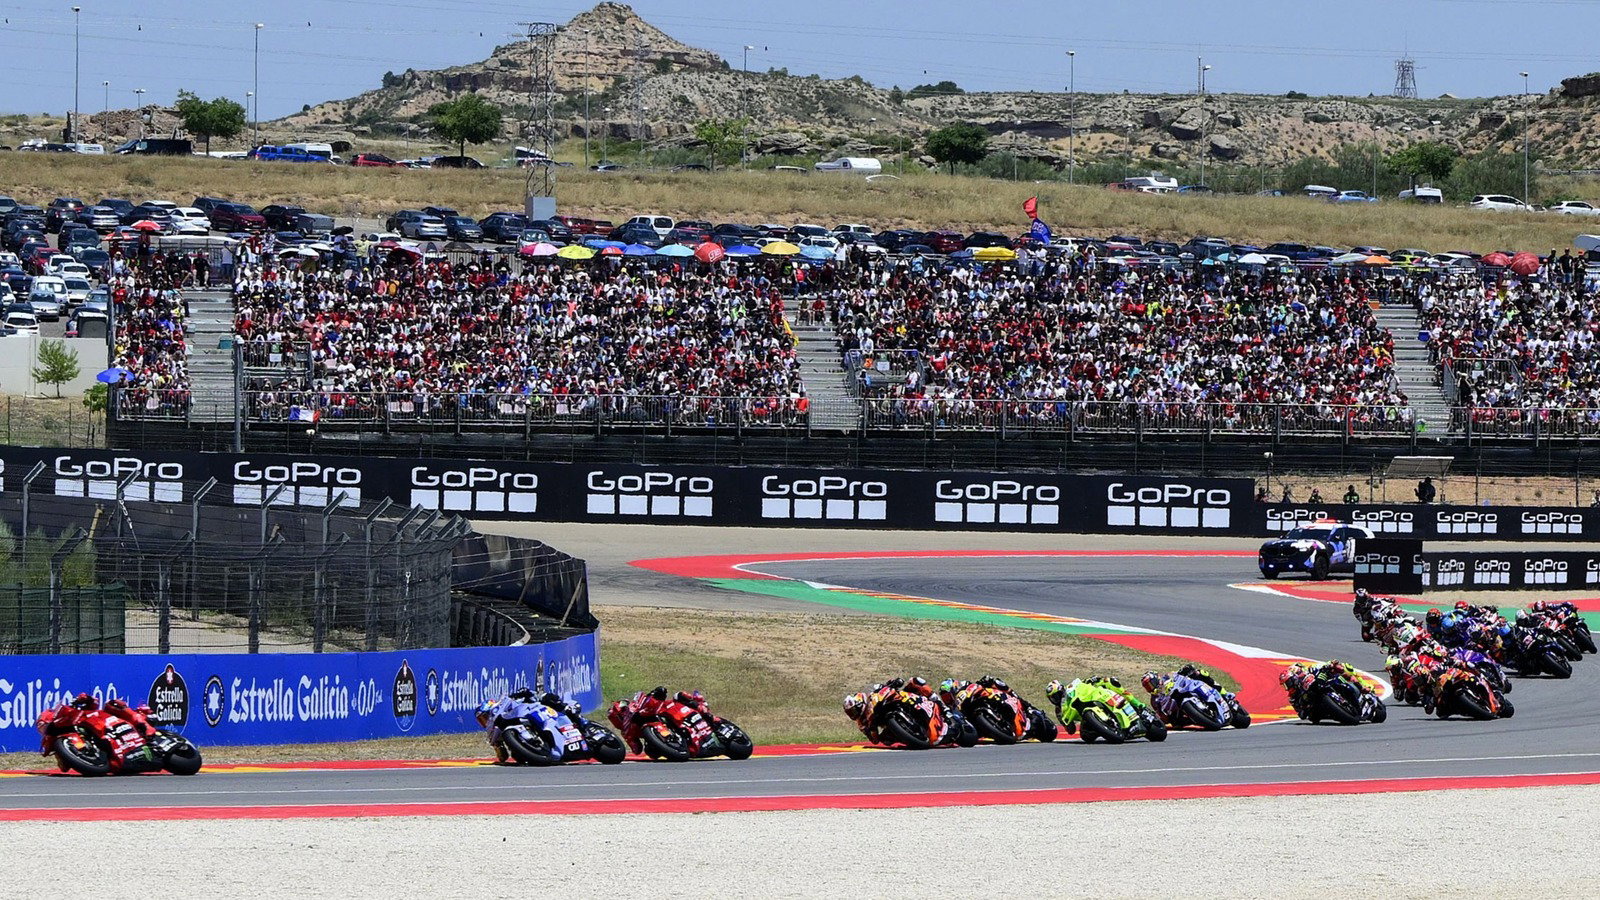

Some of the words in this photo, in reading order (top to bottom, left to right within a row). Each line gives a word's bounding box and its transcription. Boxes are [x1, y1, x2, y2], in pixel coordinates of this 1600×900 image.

[55, 455, 183, 480] GoPro
[234, 460, 362, 485] GoPro
[411, 466, 538, 489] GoPro
[587, 470, 714, 493] GoPro
[761, 475, 887, 497] GoPro
[935, 479, 1060, 502] GoPro
[1107, 482, 1231, 505] GoPro
[1266, 508, 1328, 520] GoPro
[1352, 510, 1414, 521] GoPro
[1436, 511, 1498, 522] GoPro
[1521, 511, 1583, 523] GoPro
[1355, 553, 1400, 564] oPro
[1437, 559, 1465, 571] GoPro
[1474, 559, 1511, 571] GoPro
[1524, 558, 1568, 571] GoPro
[155, 686, 184, 703] Estrella
[228, 676, 294, 724] Estrella
[298, 675, 349, 722] Galicia
[441, 670, 480, 713] Estrella
[156, 704, 182, 721] Galicia
